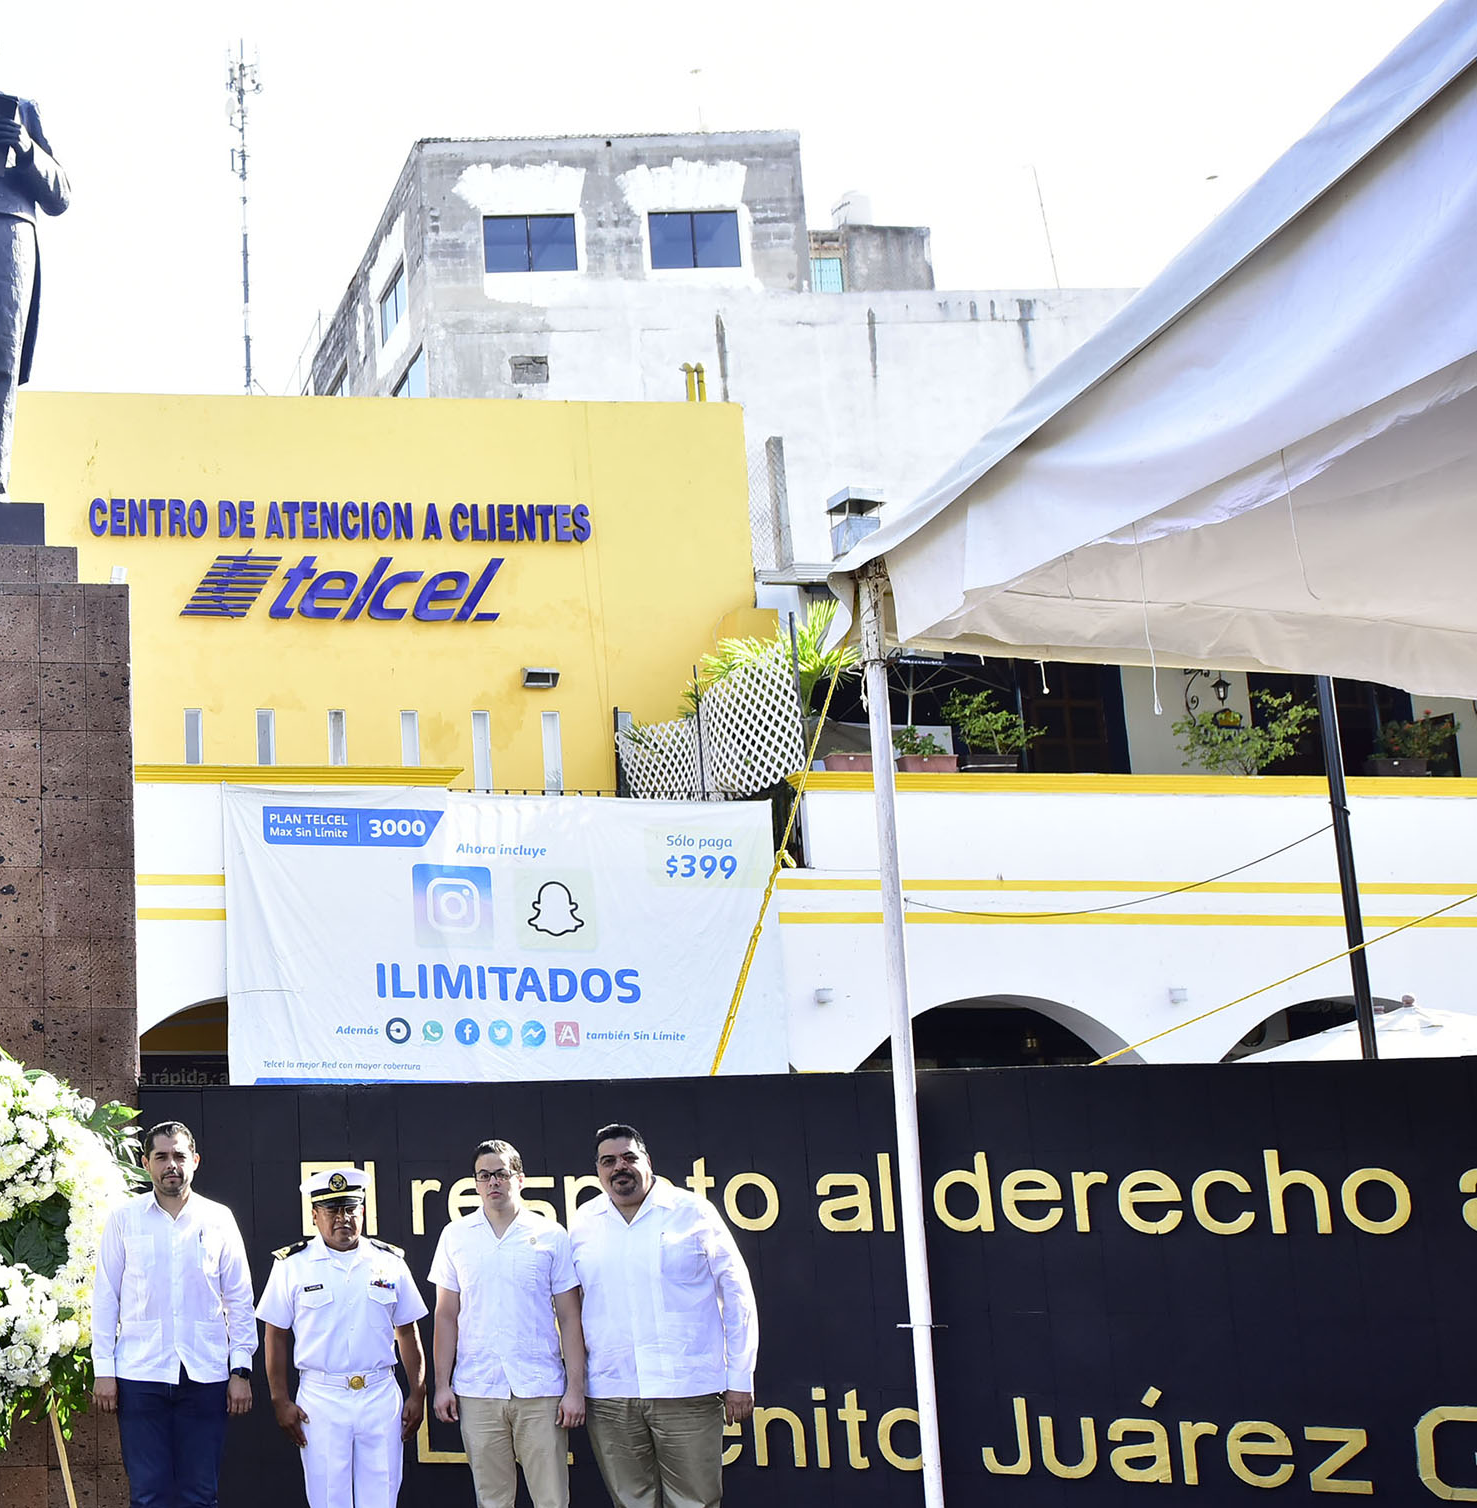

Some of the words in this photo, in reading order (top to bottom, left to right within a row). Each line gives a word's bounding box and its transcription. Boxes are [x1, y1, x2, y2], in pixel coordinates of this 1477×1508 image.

[88, 497, 207, 538] CENTRO
[218, 500, 256, 539] DE
[264, 501, 412, 541] ATENCION
[421, 502, 442, 541] A
[449, 502, 592, 543] CLIENTES
[267, 553, 505, 623] telcel
[269, 813, 302, 825] PLAN
[304, 814, 349, 826] TELCEL
[367, 818, 427, 839] 3000
[269, 826, 293, 838] Max
[295, 827, 312, 838] Sin
[314, 826, 349, 838] Límite
[455, 843, 497, 855] Ahora
[499, 843, 547, 859] incluye
[666, 834, 695, 847] Sólo
[699, 838, 733, 851] paga
[665, 854, 738, 880] $399
[375, 962, 642, 1004] ILIMITADOS
[335, 1025, 380, 1036] Además
[585, 1030, 631, 1042] también
[652, 1030, 687, 1043] Límite
[263, 1060, 285, 1068] Telcel
[286, 1060, 294, 1068] la
[296, 1060, 320, 1071] mejor
[321, 1061, 337, 1069] Red
[354, 1062, 382, 1071] mayor
[383, 1062, 422, 1071] cobertura
[410, 1156, 781, 1236] respto
[815, 1153, 896, 1233] al
[932, 1149, 1413, 1236] derecho
[981, 1385, 1374, 1495] Juárez
